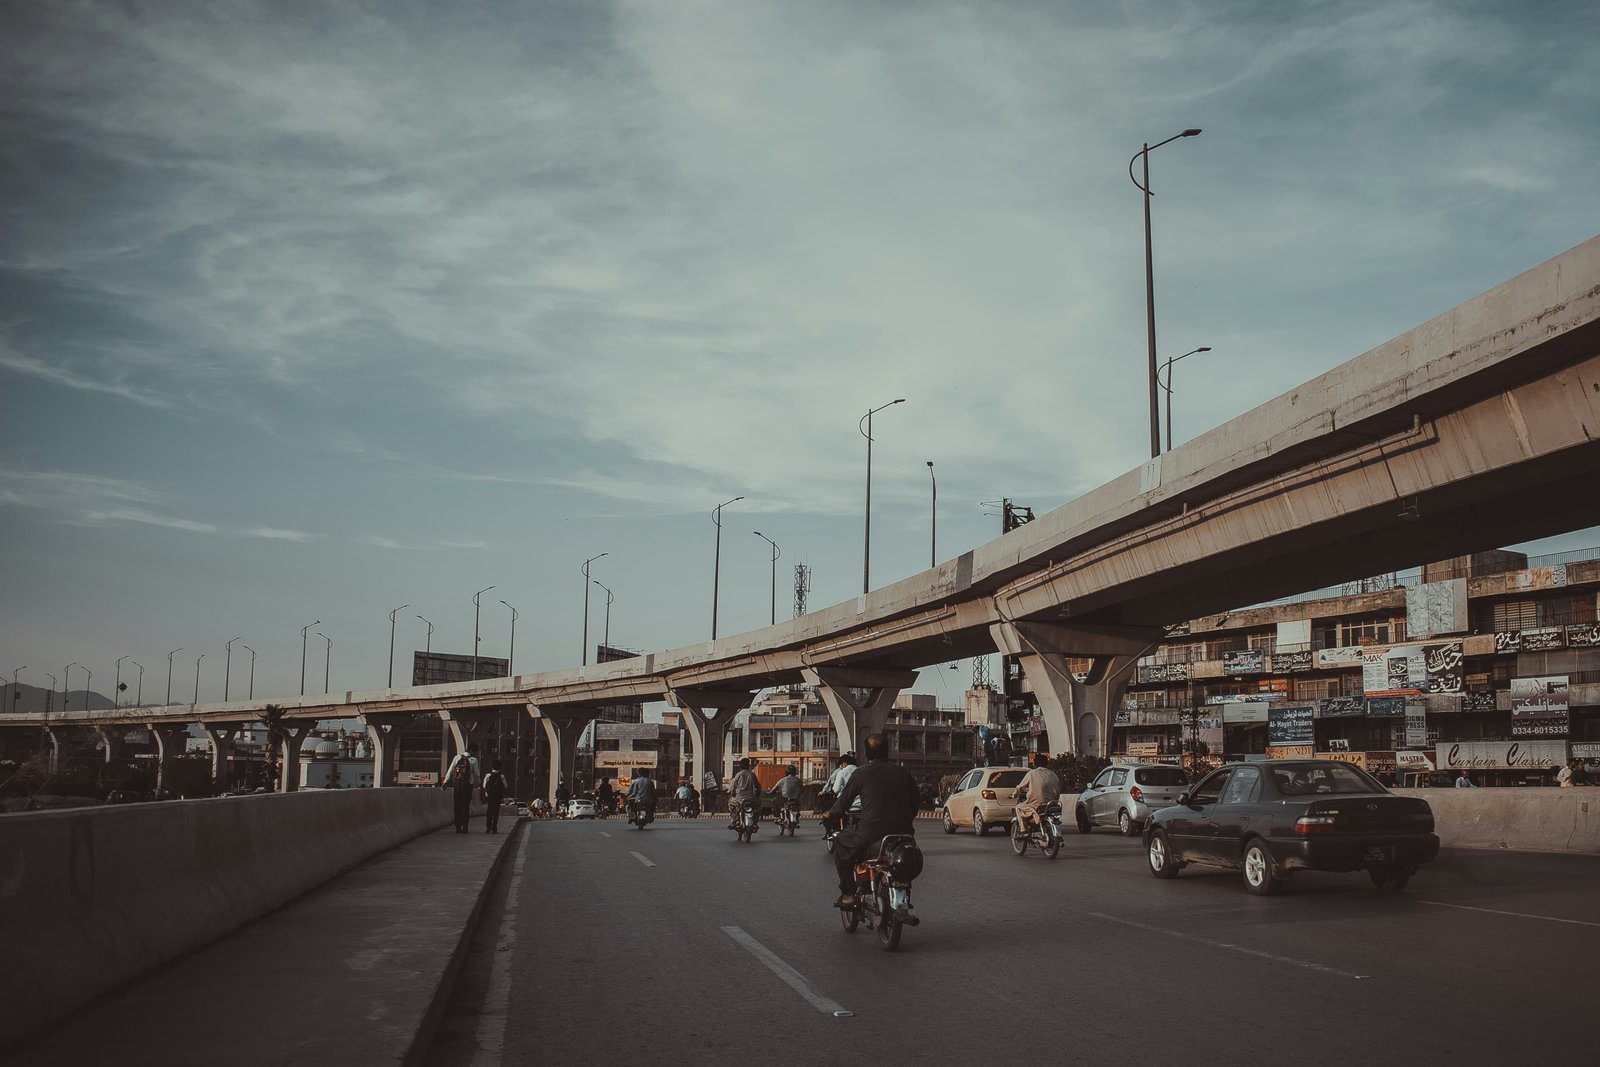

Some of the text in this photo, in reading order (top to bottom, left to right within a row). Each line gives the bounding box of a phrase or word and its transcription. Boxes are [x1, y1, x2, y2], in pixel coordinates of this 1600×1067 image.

[1363, 654, 1383, 662] MAK
[1293, 719, 1313, 727] Traders
[1512, 725, 1569, 735] 0334-6015335
[1448, 742, 1553, 767] Curtain Classic
[1399, 755, 1425, 763] MASTER
